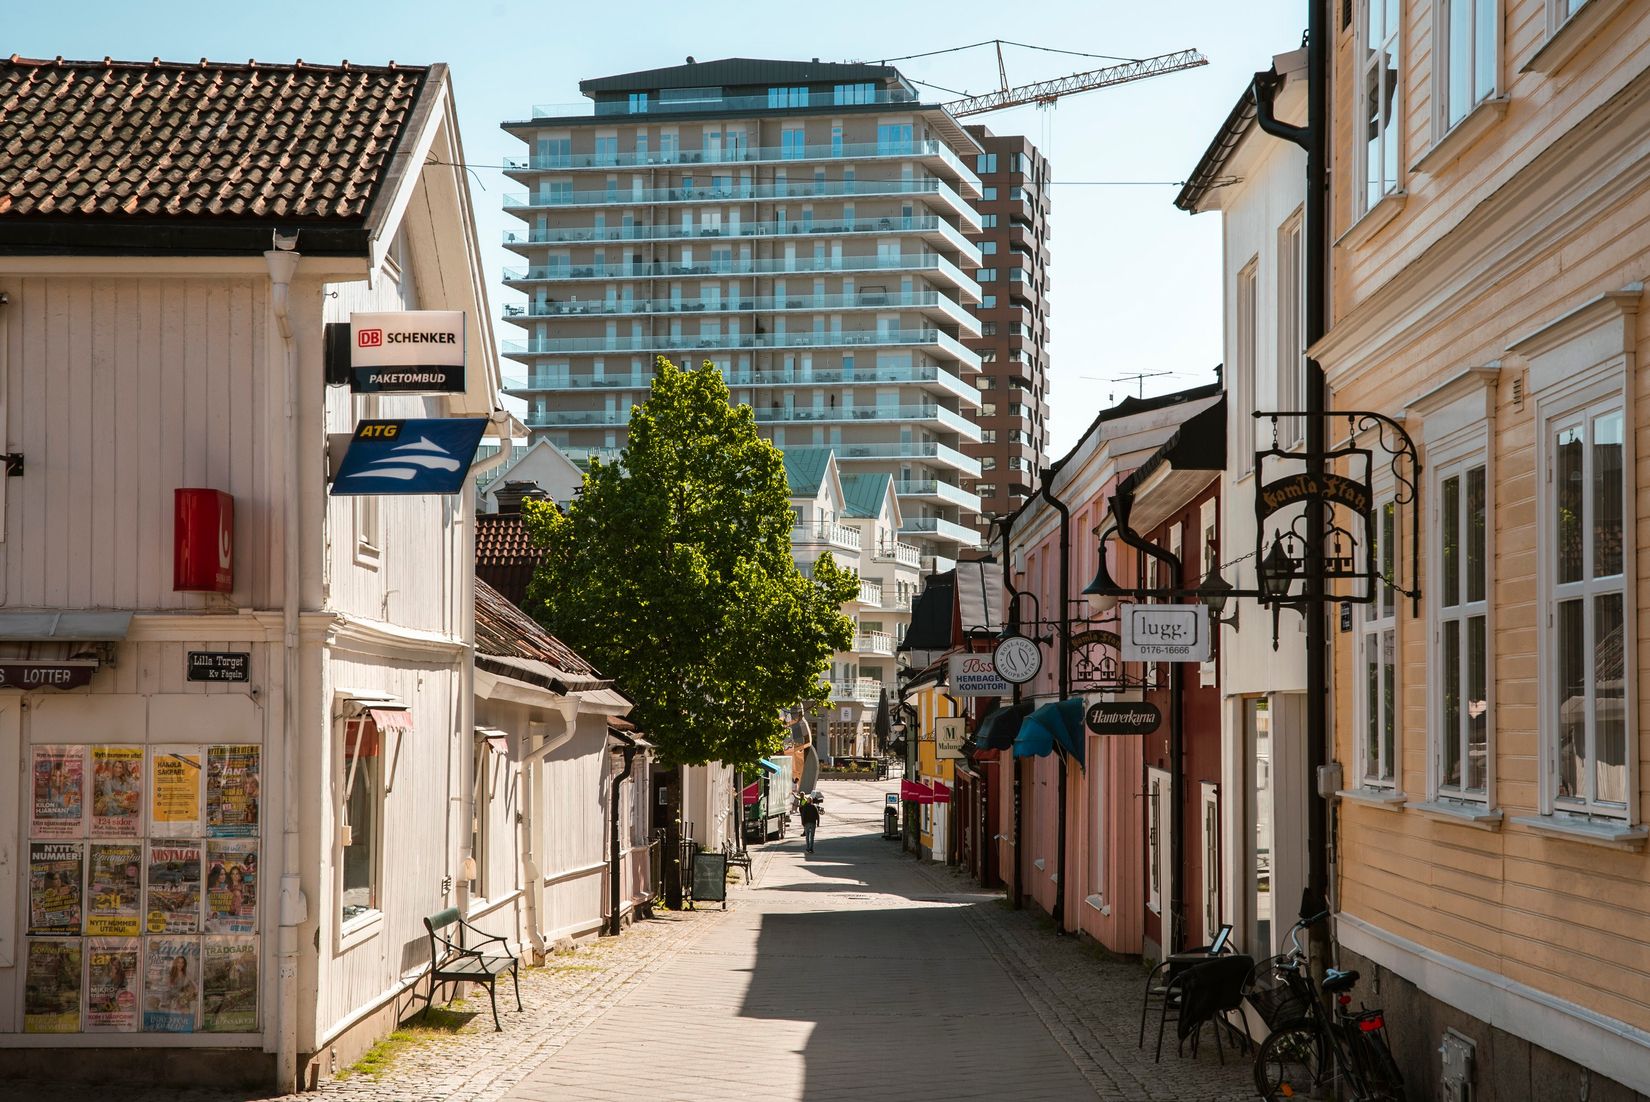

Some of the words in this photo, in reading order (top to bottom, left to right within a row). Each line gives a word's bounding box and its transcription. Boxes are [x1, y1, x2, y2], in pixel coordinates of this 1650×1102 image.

[361, 331, 380, 345] DB
[387, 332, 456, 344] SCHENKER
[369, 373, 446, 383] PAKETOMBUD
[360, 425, 398, 437] ATG
[1142, 616, 1187, 640] lugg.
[1140, 646, 1190, 655] 0176-16666
[193, 655, 213, 666] Lilla
[216, 655, 243, 671] Torget
[23, 669, 71, 684] LOTTER
[208, 669, 219, 678] Kv
[959, 682, 1007, 691] KONDITORI
[1090, 709, 1156, 727] Hantverkarna
[945, 727, 955, 739] M
[112, 817, 133, 826] sidor
[44, 844, 72, 853] NYTT
[32, 852, 83, 861] NUMMER!
[151, 848, 201, 864] NOSTALGIA
